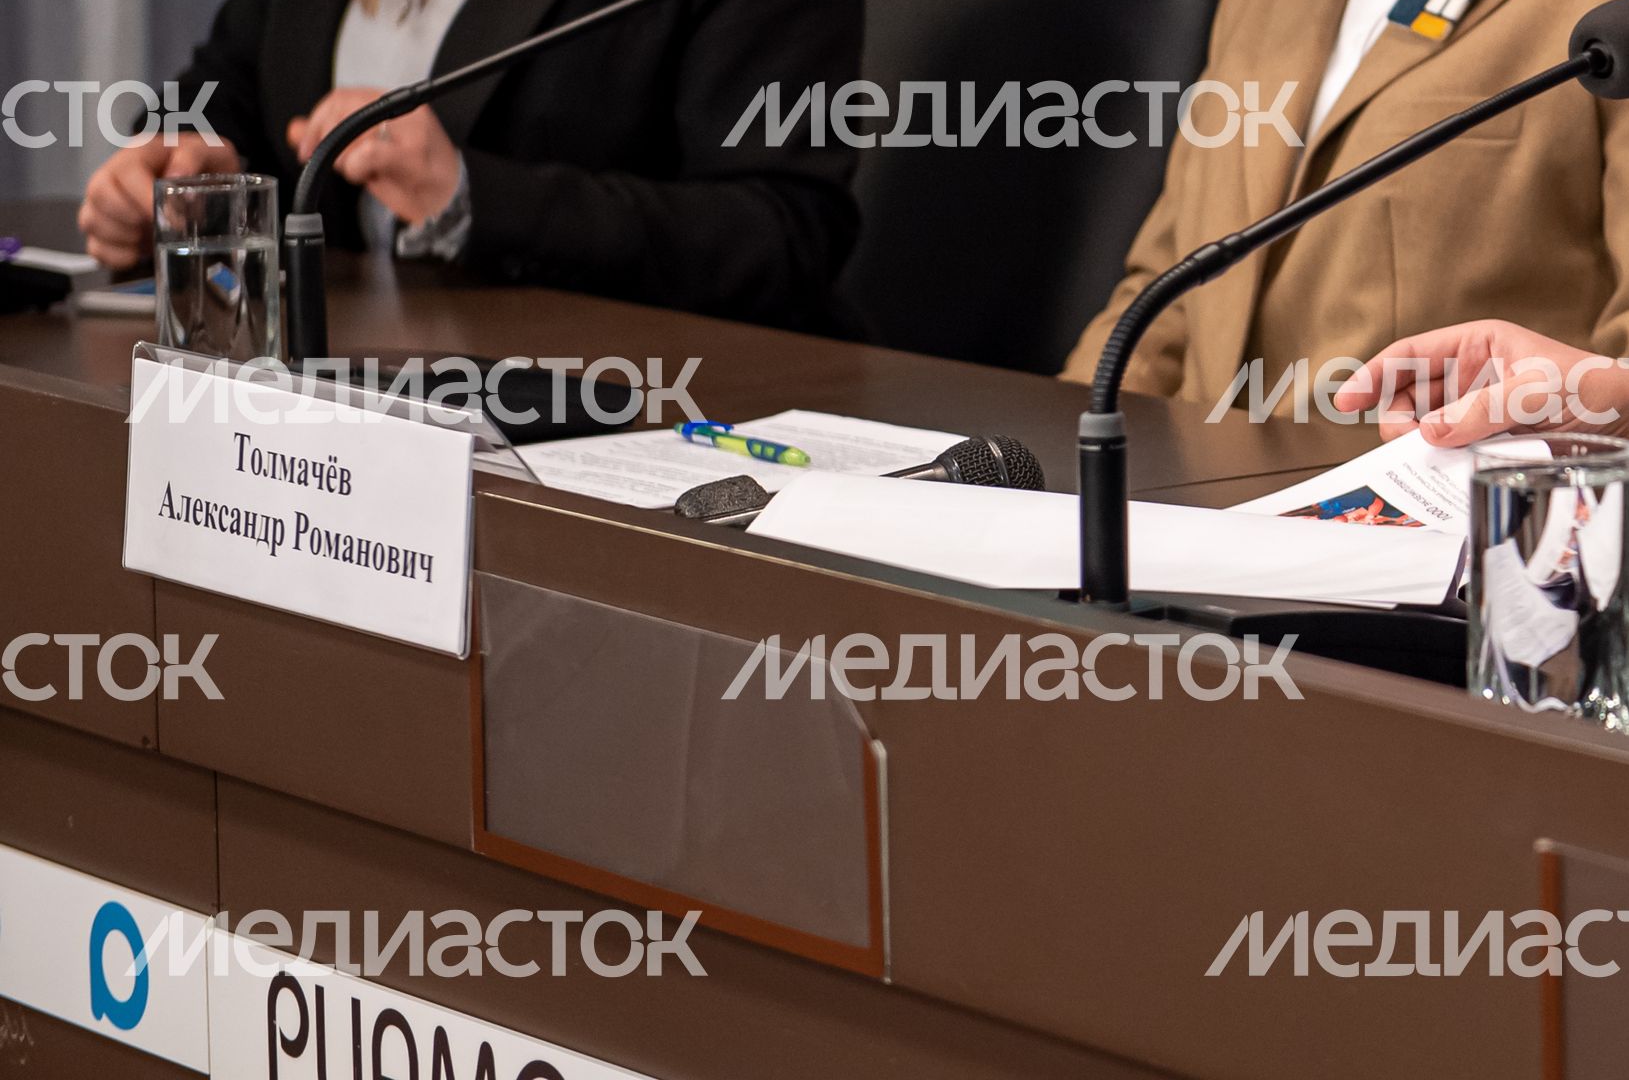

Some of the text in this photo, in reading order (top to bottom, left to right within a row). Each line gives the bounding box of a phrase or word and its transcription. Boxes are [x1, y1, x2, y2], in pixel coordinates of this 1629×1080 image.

[233, 431, 352, 496] Толмачёв
[158, 480, 434, 584] Александр Романович
